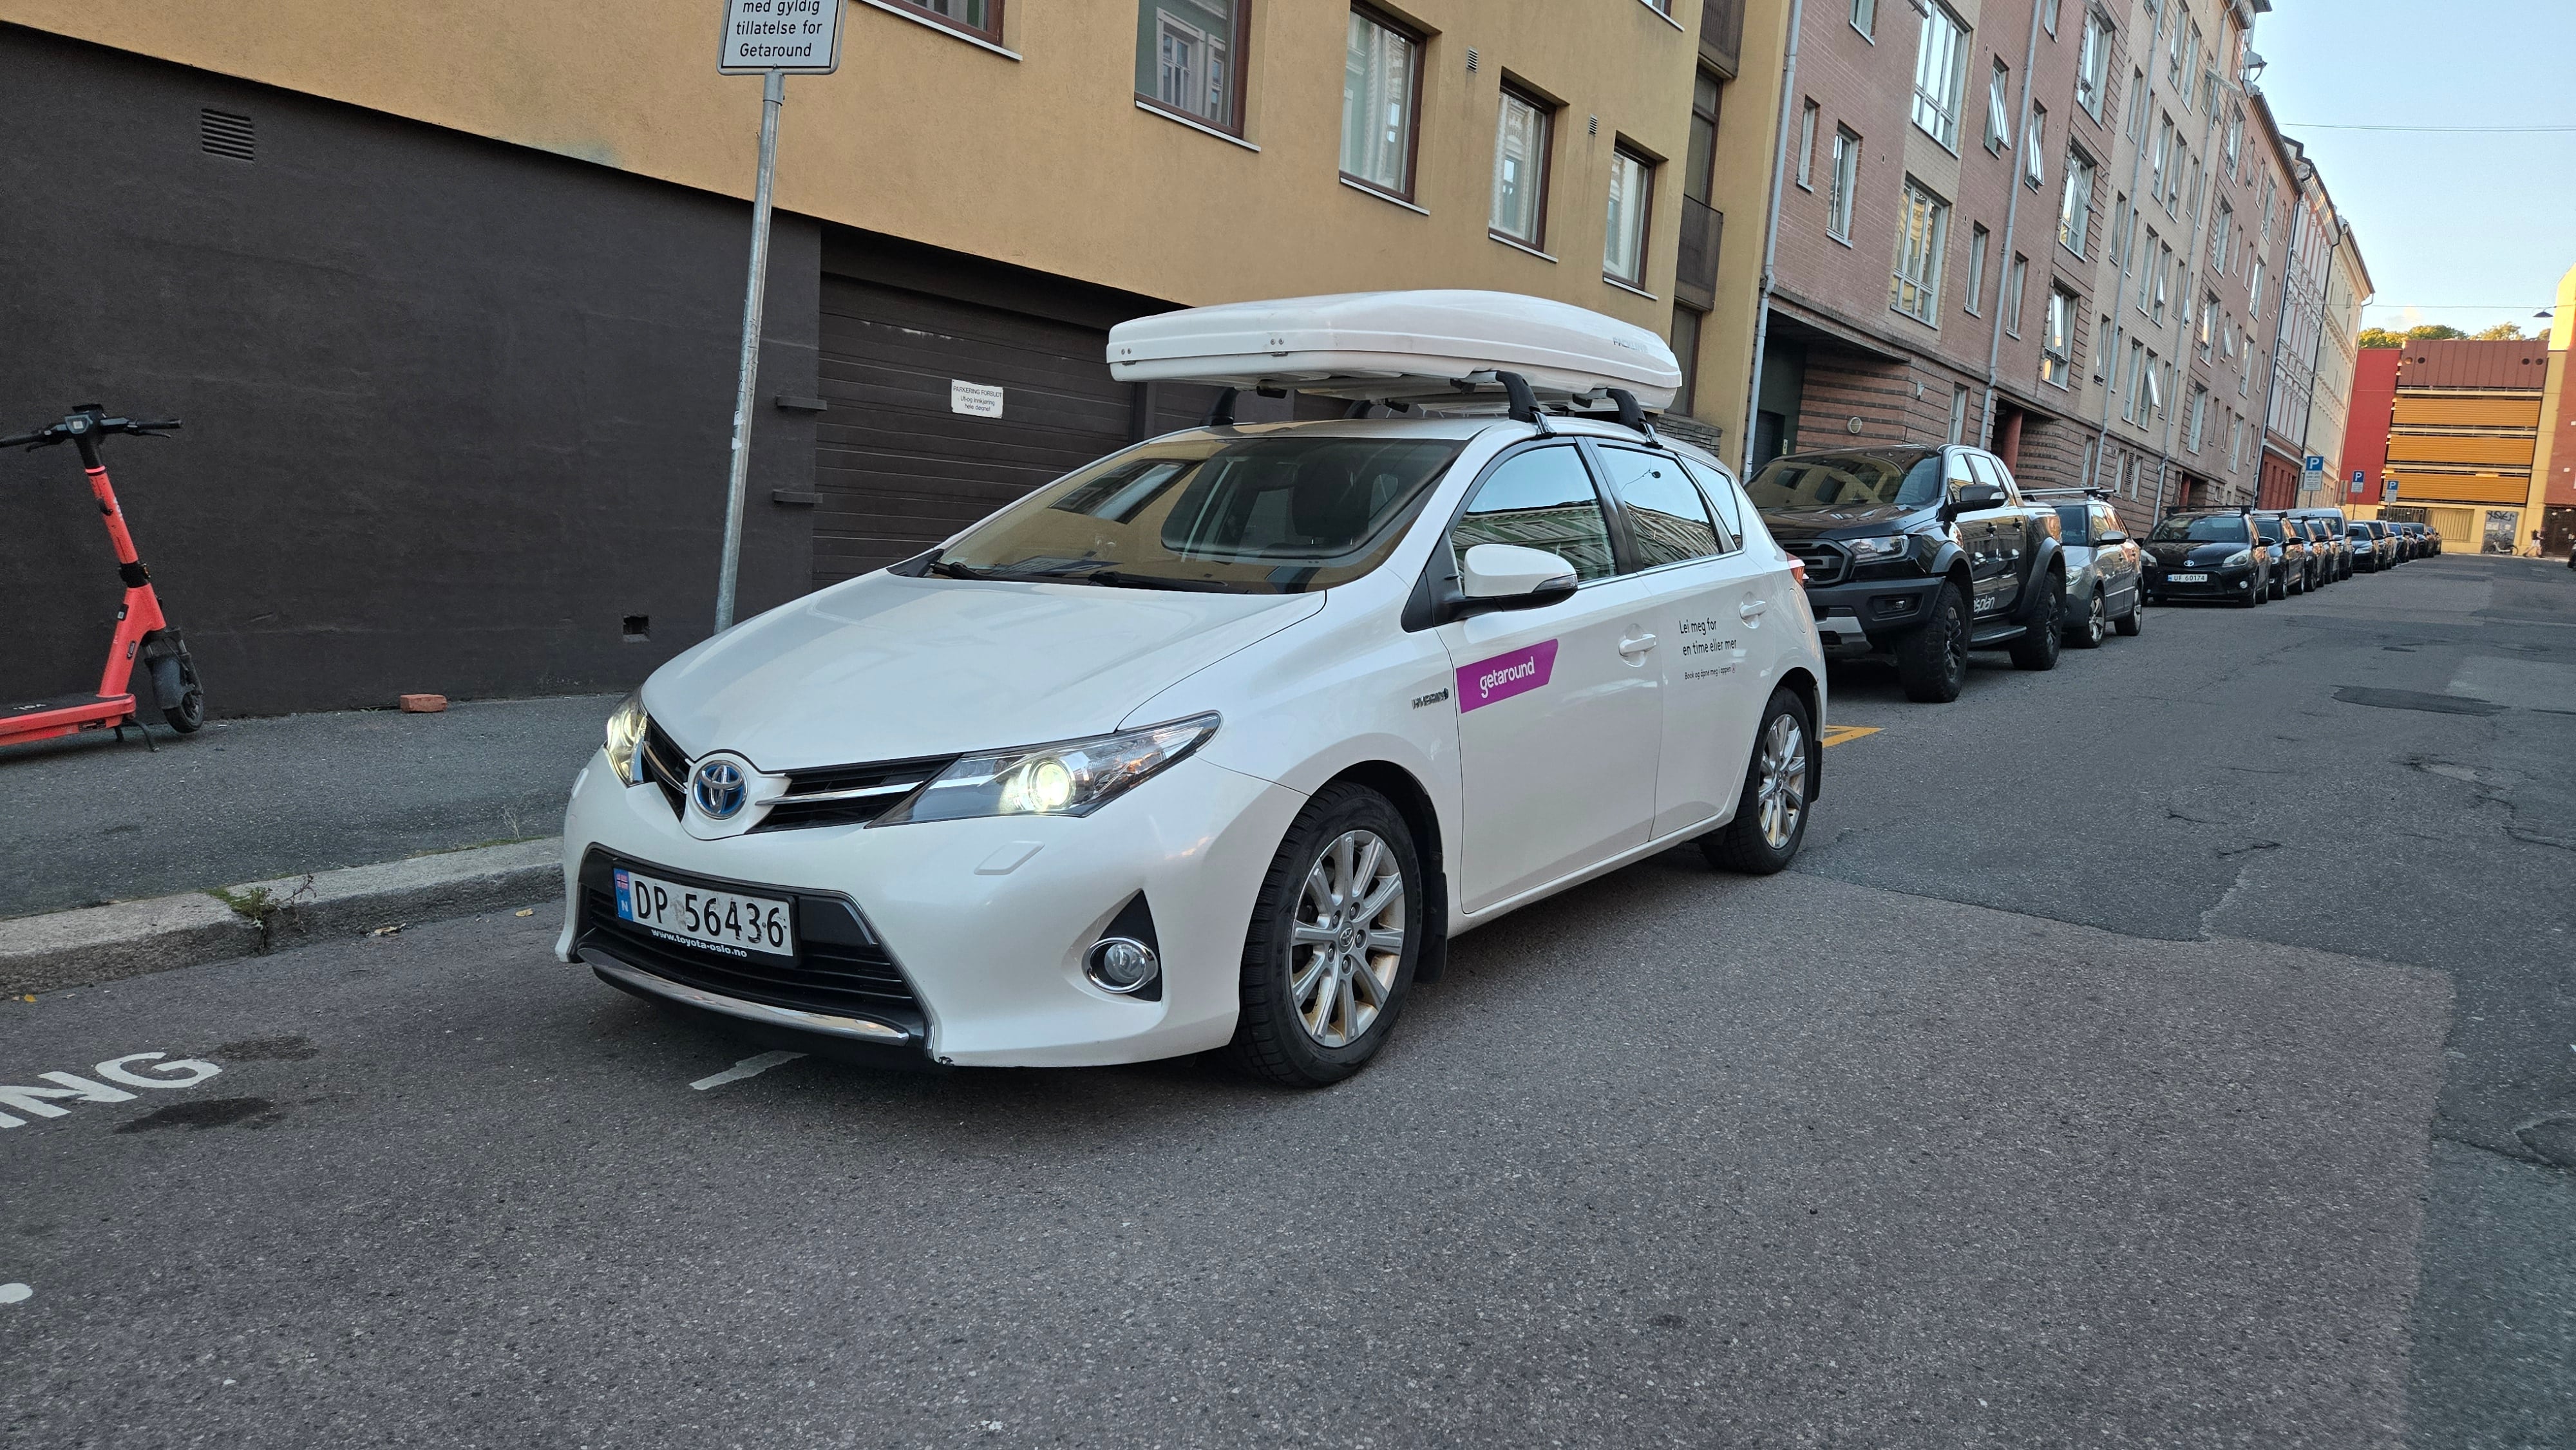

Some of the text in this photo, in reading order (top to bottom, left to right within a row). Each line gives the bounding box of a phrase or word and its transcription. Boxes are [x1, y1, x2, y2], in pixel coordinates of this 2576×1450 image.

[743, 0, 820, 15] med gyldig
[736, 20, 823, 35] tillatelse for
[740, 42, 812, 57] Getaround
[953, 386, 1002, 398] PARKERING FORBUDT
[2309, 458, 2320, 469] P
[2355, 472, 2362, 482] P
[1679, 617, 1717, 636] Lei meg for
[1683, 638, 1737, 655] en time eller mer
[1479, 656, 1535, 699] getaround
[1685, 671, 1694, 680] Book
[1695, 672, 1700, 680] og
[620, 902, 629, 912] N
[634, 880, 784, 948] DP 56436
[651, 929, 748, 957] www.toyota-oslo.no
[0, 1052, 223, 1128] NG
